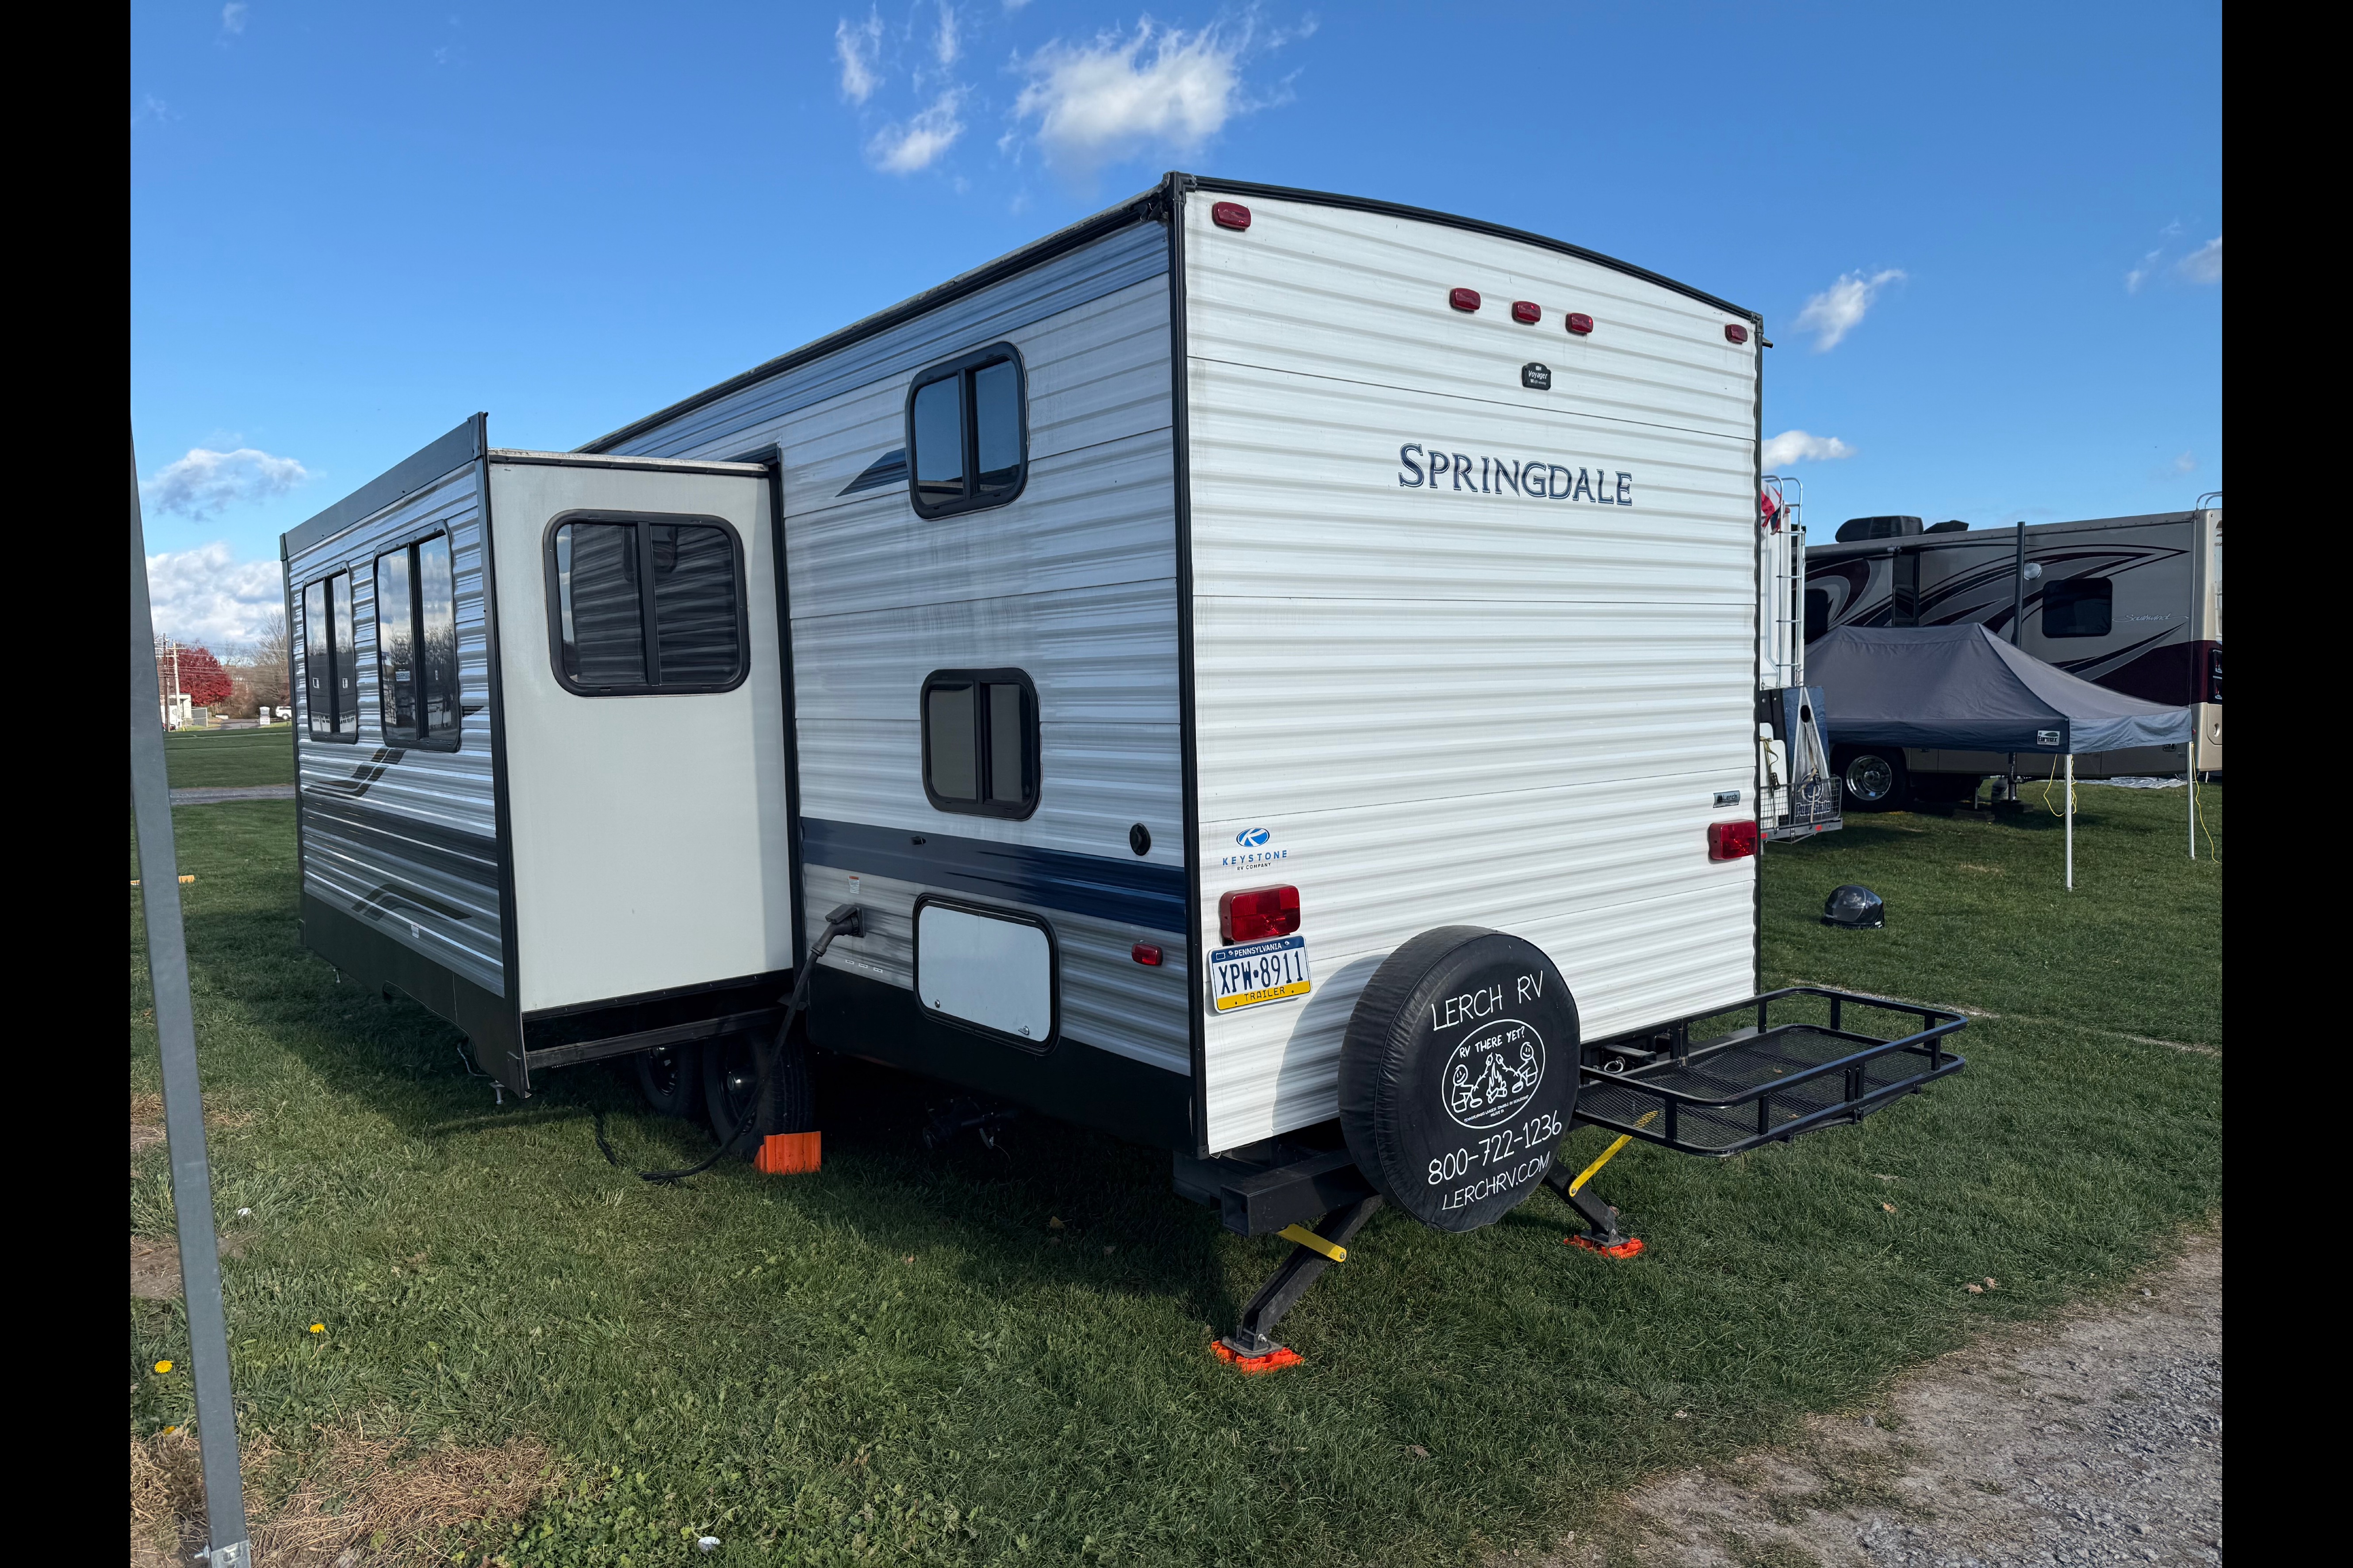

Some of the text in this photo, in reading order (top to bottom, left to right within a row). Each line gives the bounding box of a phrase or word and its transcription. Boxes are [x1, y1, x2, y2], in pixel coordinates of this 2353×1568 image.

[1528, 370, 1548, 380] Voyager
[1398, 442, 1633, 506] SPRINGDALE
[1222, 849, 1288, 866] KEYSTONE
[1234, 942, 1282, 957] PENNSYLVANIA
[1244, 987, 1285, 1001] TRAILER
[1431, 970, 1543, 1031] LERCH RV
[1459, 1026, 1525, 1058] RV THERE YET?
[1428, 1109, 1562, 1185] 800-722-1236
[1441, 1151, 1550, 1210] LERCHRV.COM
